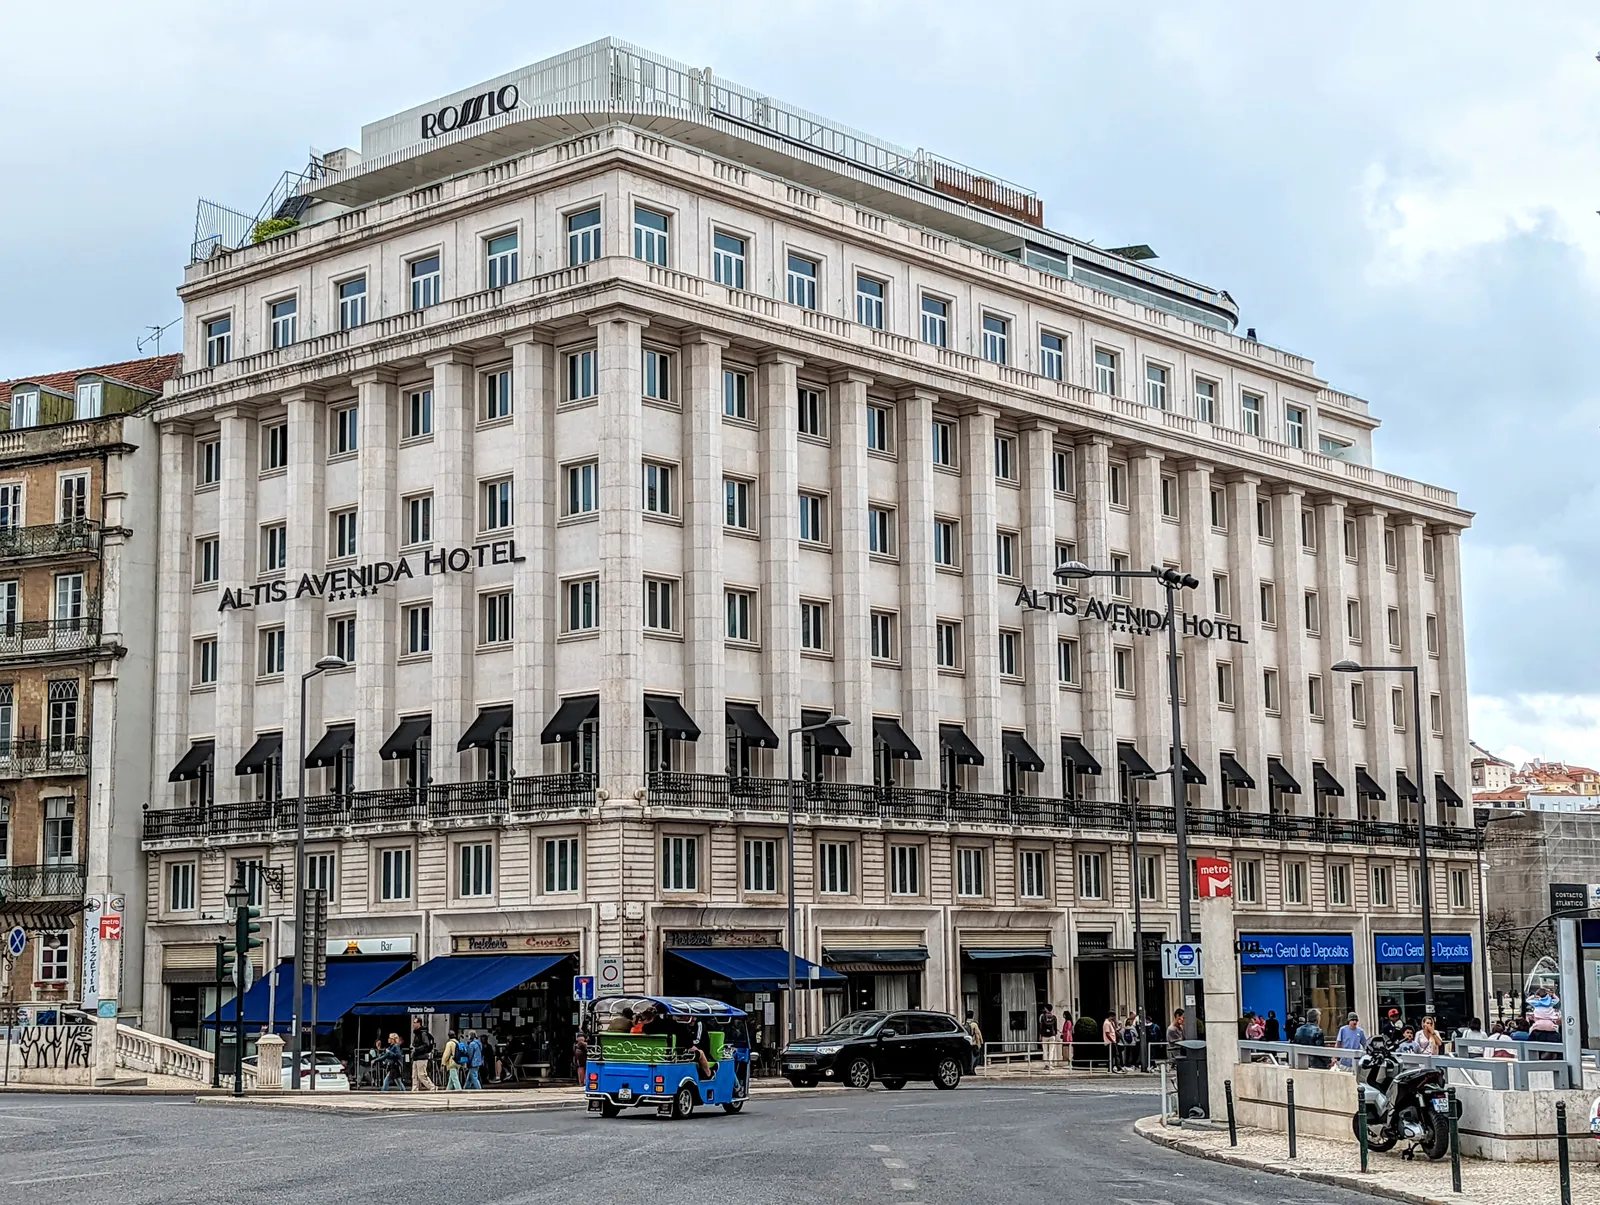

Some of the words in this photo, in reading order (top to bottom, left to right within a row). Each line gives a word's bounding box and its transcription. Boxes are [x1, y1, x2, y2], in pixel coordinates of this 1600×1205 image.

[421, 84, 519, 139] ROSSIO
[217, 580, 287, 612] ALTIS
[295, 557, 413, 599] AVENIDA
[424, 540, 526, 576] HOTEL
[1015, 585, 1078, 616] ALTIS
[1084, 597, 1171, 629] AVENIDA
[1182, 613, 1249, 644] HOTEL
[1201, 865, 1229, 875] metro
[88, 927, 99, 993] Pizzeria
[380, 940, 393, 952] Bar
[1275, 942, 1298, 958] Geral
[1300, 943, 1311, 958] de
[1381, 942, 1404, 957] Caixa
[1405, 942, 1425, 957] Geral
